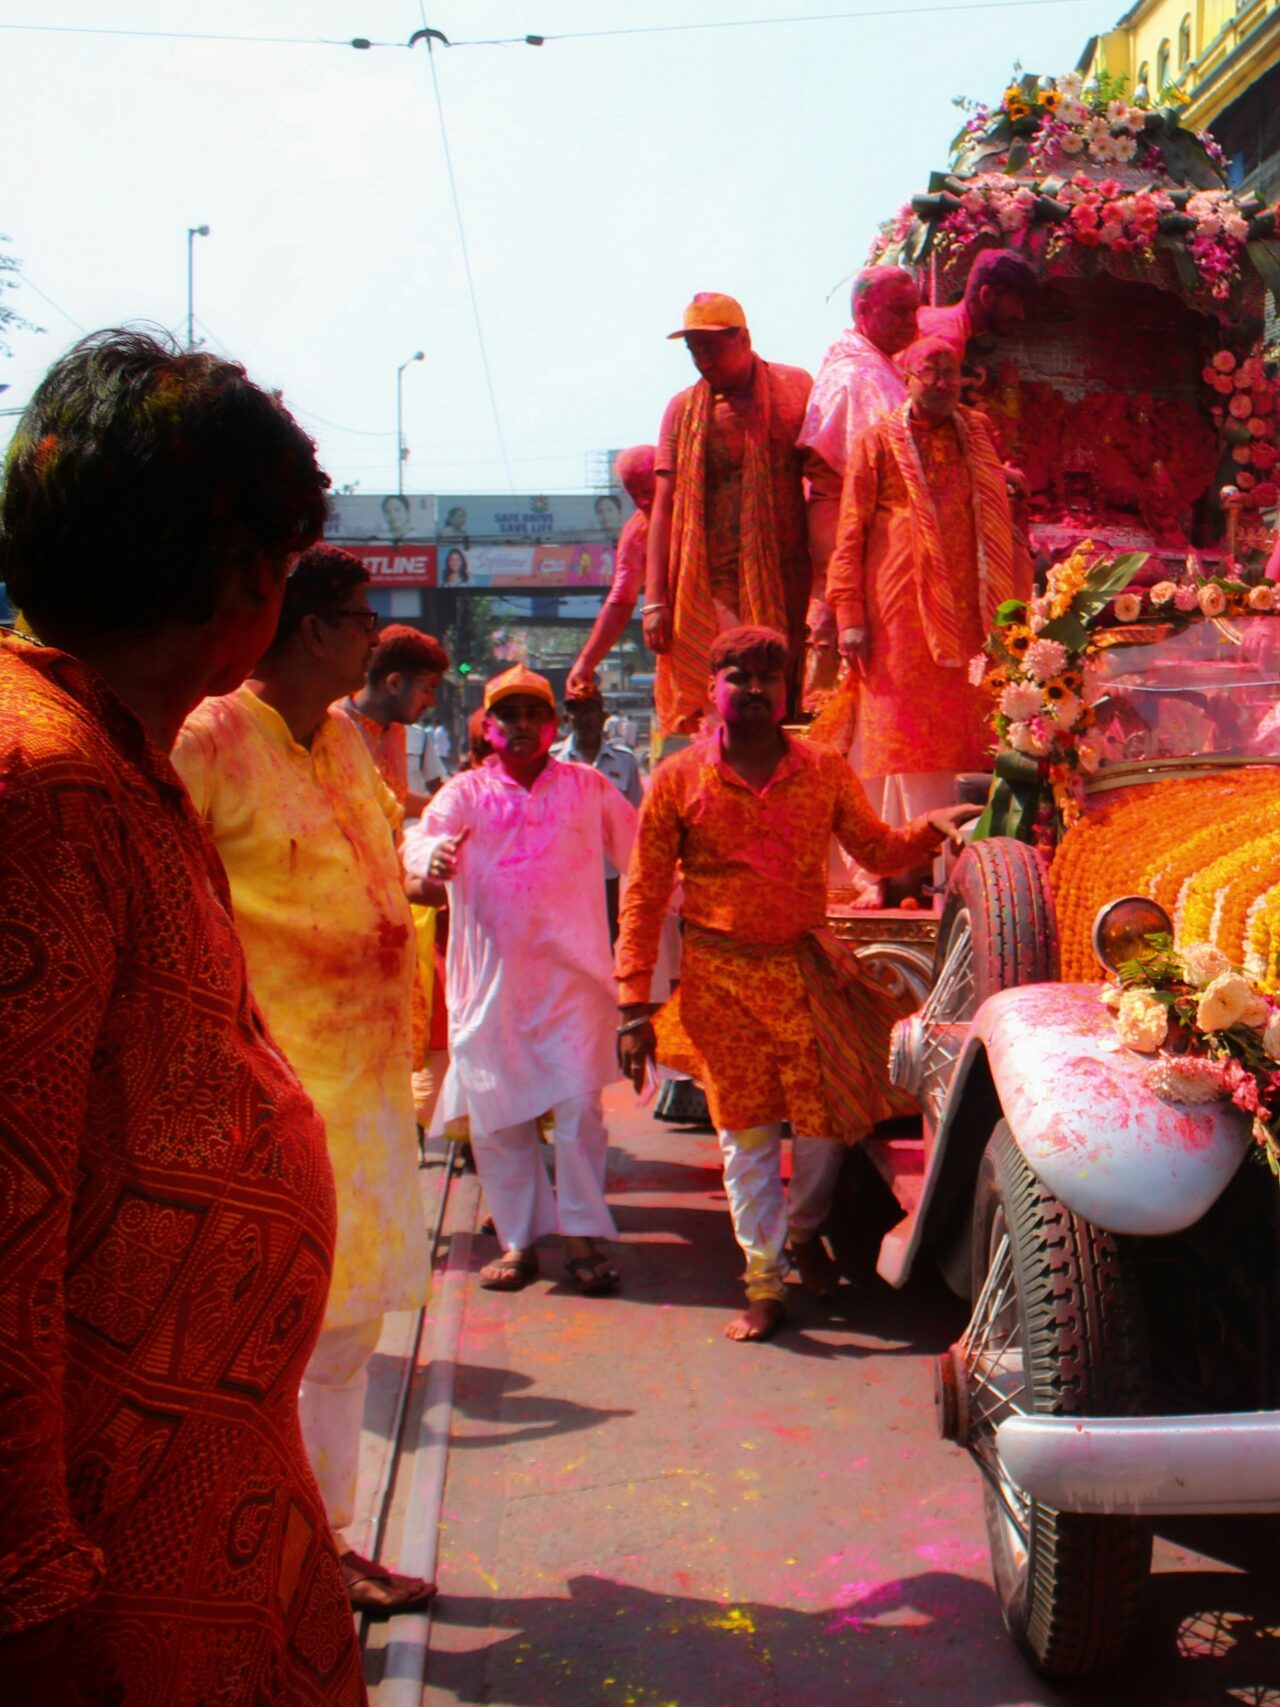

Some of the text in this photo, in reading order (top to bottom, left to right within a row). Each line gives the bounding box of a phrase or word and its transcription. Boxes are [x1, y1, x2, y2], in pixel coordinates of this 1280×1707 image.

[494, 513, 553, 523] SAFE DRIVE
[500, 523, 553, 532] SAVE LIFE
